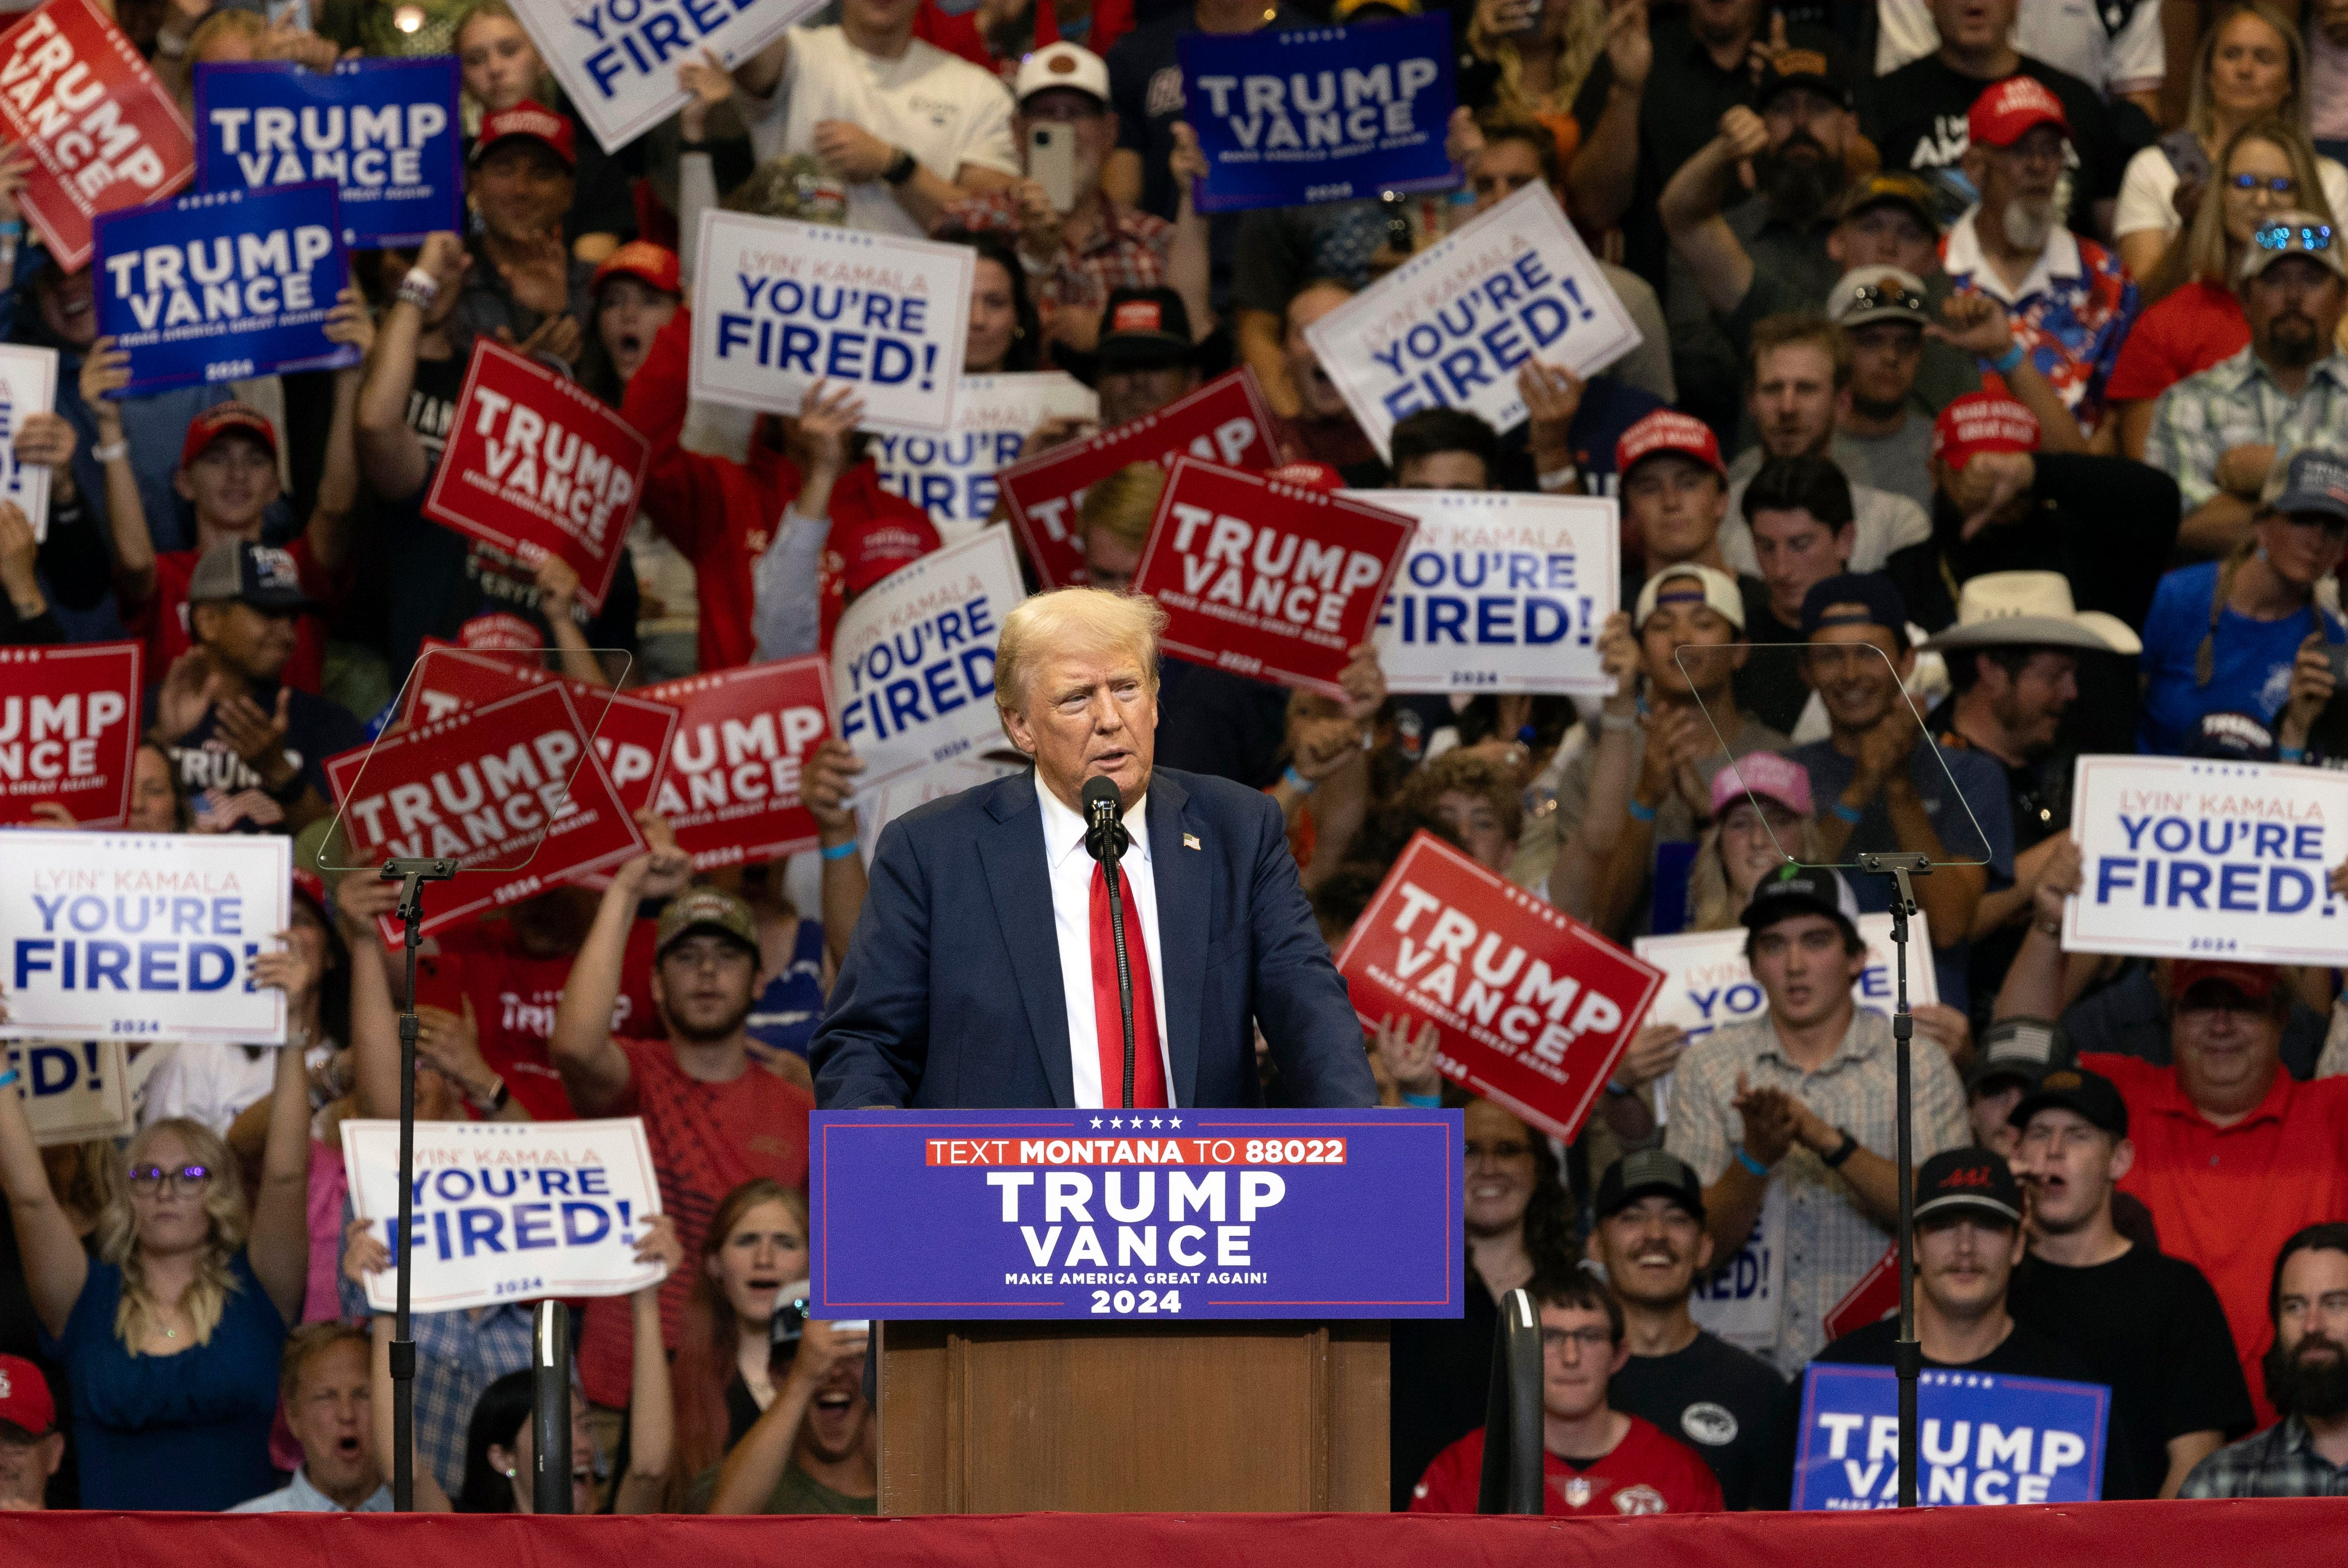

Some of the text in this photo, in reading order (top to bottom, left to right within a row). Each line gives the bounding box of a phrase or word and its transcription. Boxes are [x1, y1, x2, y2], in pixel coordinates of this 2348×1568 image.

[584, 0, 757, 99] FIRE
[14, 12, 164, 188] TRUMP
[1196, 57, 1438, 118] TRUMP
[0, 50, 116, 200] VANCE
[210, 102, 447, 155] TRUMP
[1229, 100, 1415, 149] VANCE
[237, 148, 423, 188] VANCE
[106, 224, 333, 299] TRUMP
[129, 271, 315, 330] VANCE
[737, 270, 928, 334] YOU'RE
[1373, 249, 1552, 376] YOU'RE
[717, 310, 938, 391] FIRED!
[474, 384, 634, 504] TRUMP
[484, 437, 610, 541] VANCE
[1171, 501, 1385, 596] TRUMP
[1408, 550, 1577, 590] OU'RE
[1183, 553, 1348, 632] VANCE
[848, 594, 996, 692] YOU'RE
[841, 645, 997, 741] FIRED
[671, 706, 824, 775] UMP
[351, 730, 580, 846] TRUMP
[654, 754, 802, 817] ANCE
[2118, 789, 2325, 822] LYIN' KAMALA
[385, 779, 580, 859] VANCE
[2118, 813, 2325, 861] YOU'RE
[33, 868, 241, 892] LYIN' KAMALA
[2095, 855, 2337, 917] FIRED!
[32, 894, 243, 935] YOU'RE
[2189, 936, 2238, 951] 2024
[13, 938, 260, 994] FIRED!
[1393, 881, 1622, 1037] TRUMP
[111, 1020, 160, 1035] 2024
[1396, 936, 1577, 1066] VANCE
[473, 1147, 602, 1166] KAMALA
[930, 1139, 1343, 1164] TEXT MONTANA TO 88022
[394, 1167, 610, 1206] YOU'RE
[986, 1171, 1286, 1223] TRUMP
[385, 1199, 636, 1268] FIRED!
[1020, 1225, 1251, 1267] VANCE
[494, 1276, 543, 1296] 2024
[1005, 1272, 1267, 1284] MAKE AMERICA GREAT AGAIN!
[1090, 1289, 1182, 1314] 2024
[1818, 1412, 2086, 1478] TRUMP
